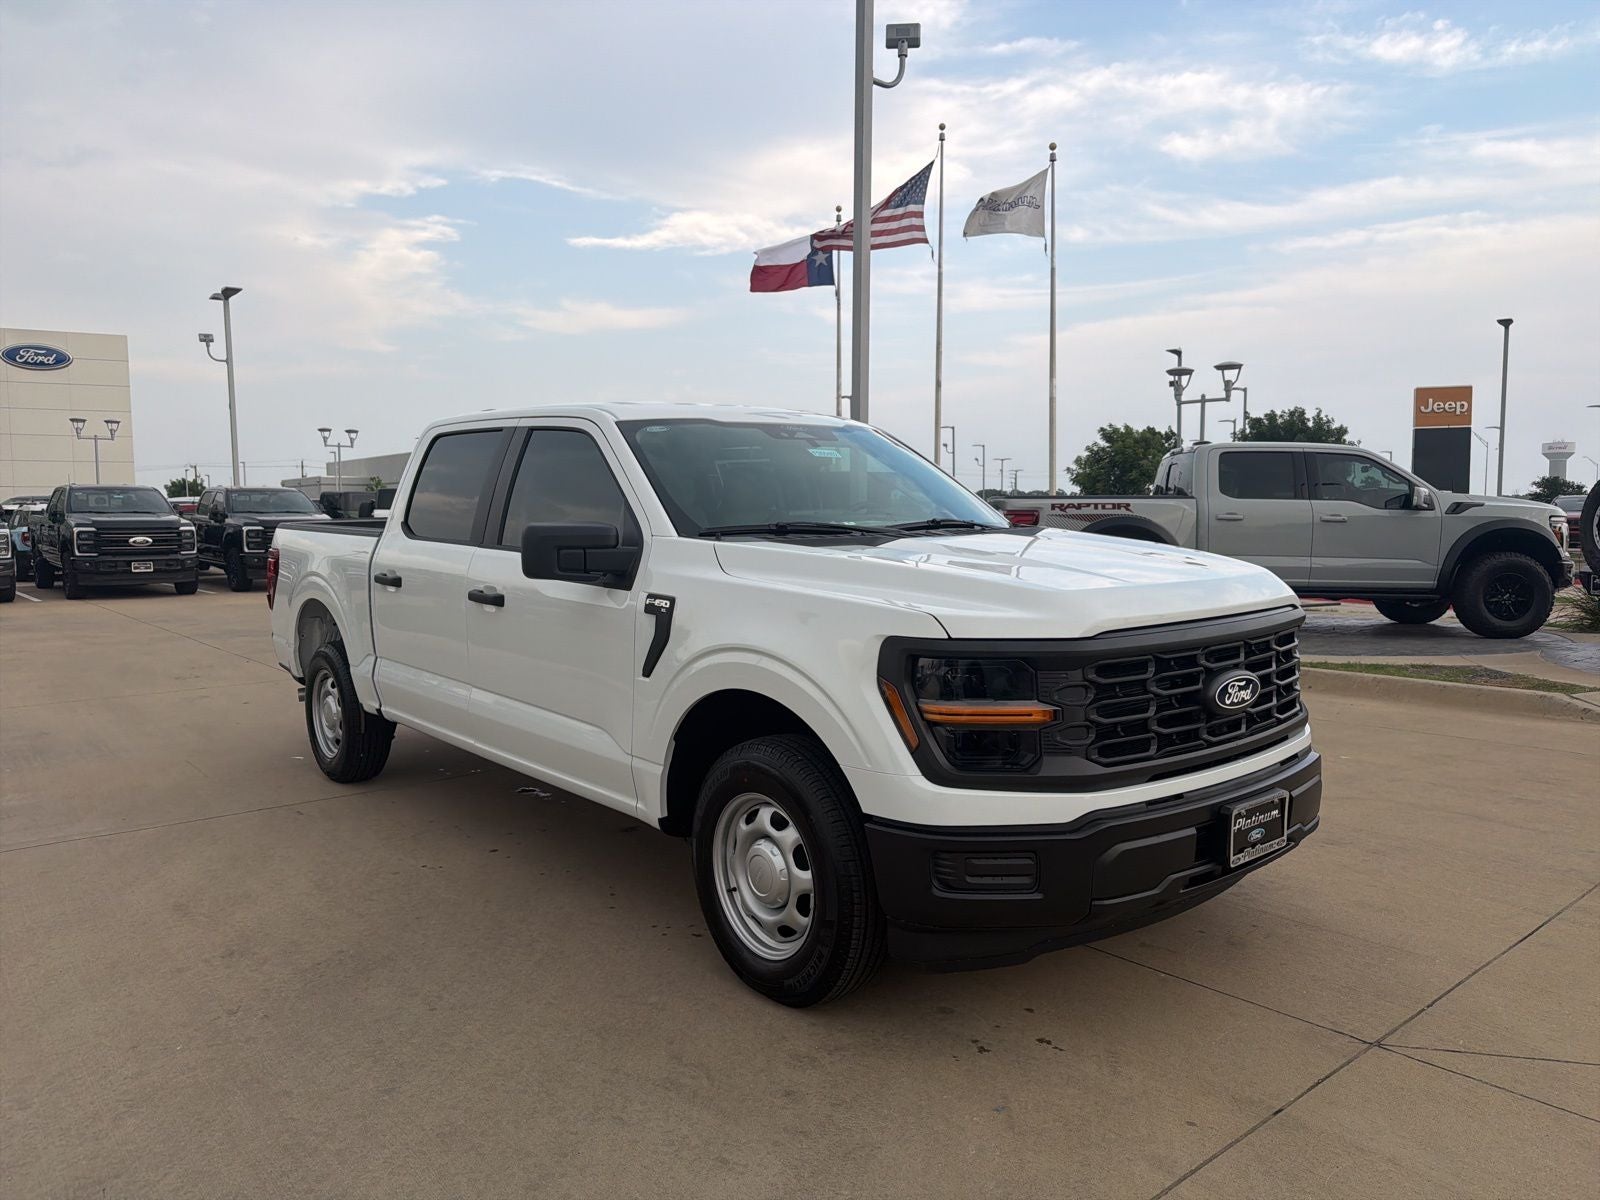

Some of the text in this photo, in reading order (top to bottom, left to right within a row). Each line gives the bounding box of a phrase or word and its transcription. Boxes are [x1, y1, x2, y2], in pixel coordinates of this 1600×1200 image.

[16, 348, 57, 365] Ford
[1420, 398, 1468, 415] Jeep
[1051, 502, 1133, 513] RAPTOR
[1225, 680, 1252, 705] Ford
[1232, 809, 1281, 832] Platinum
